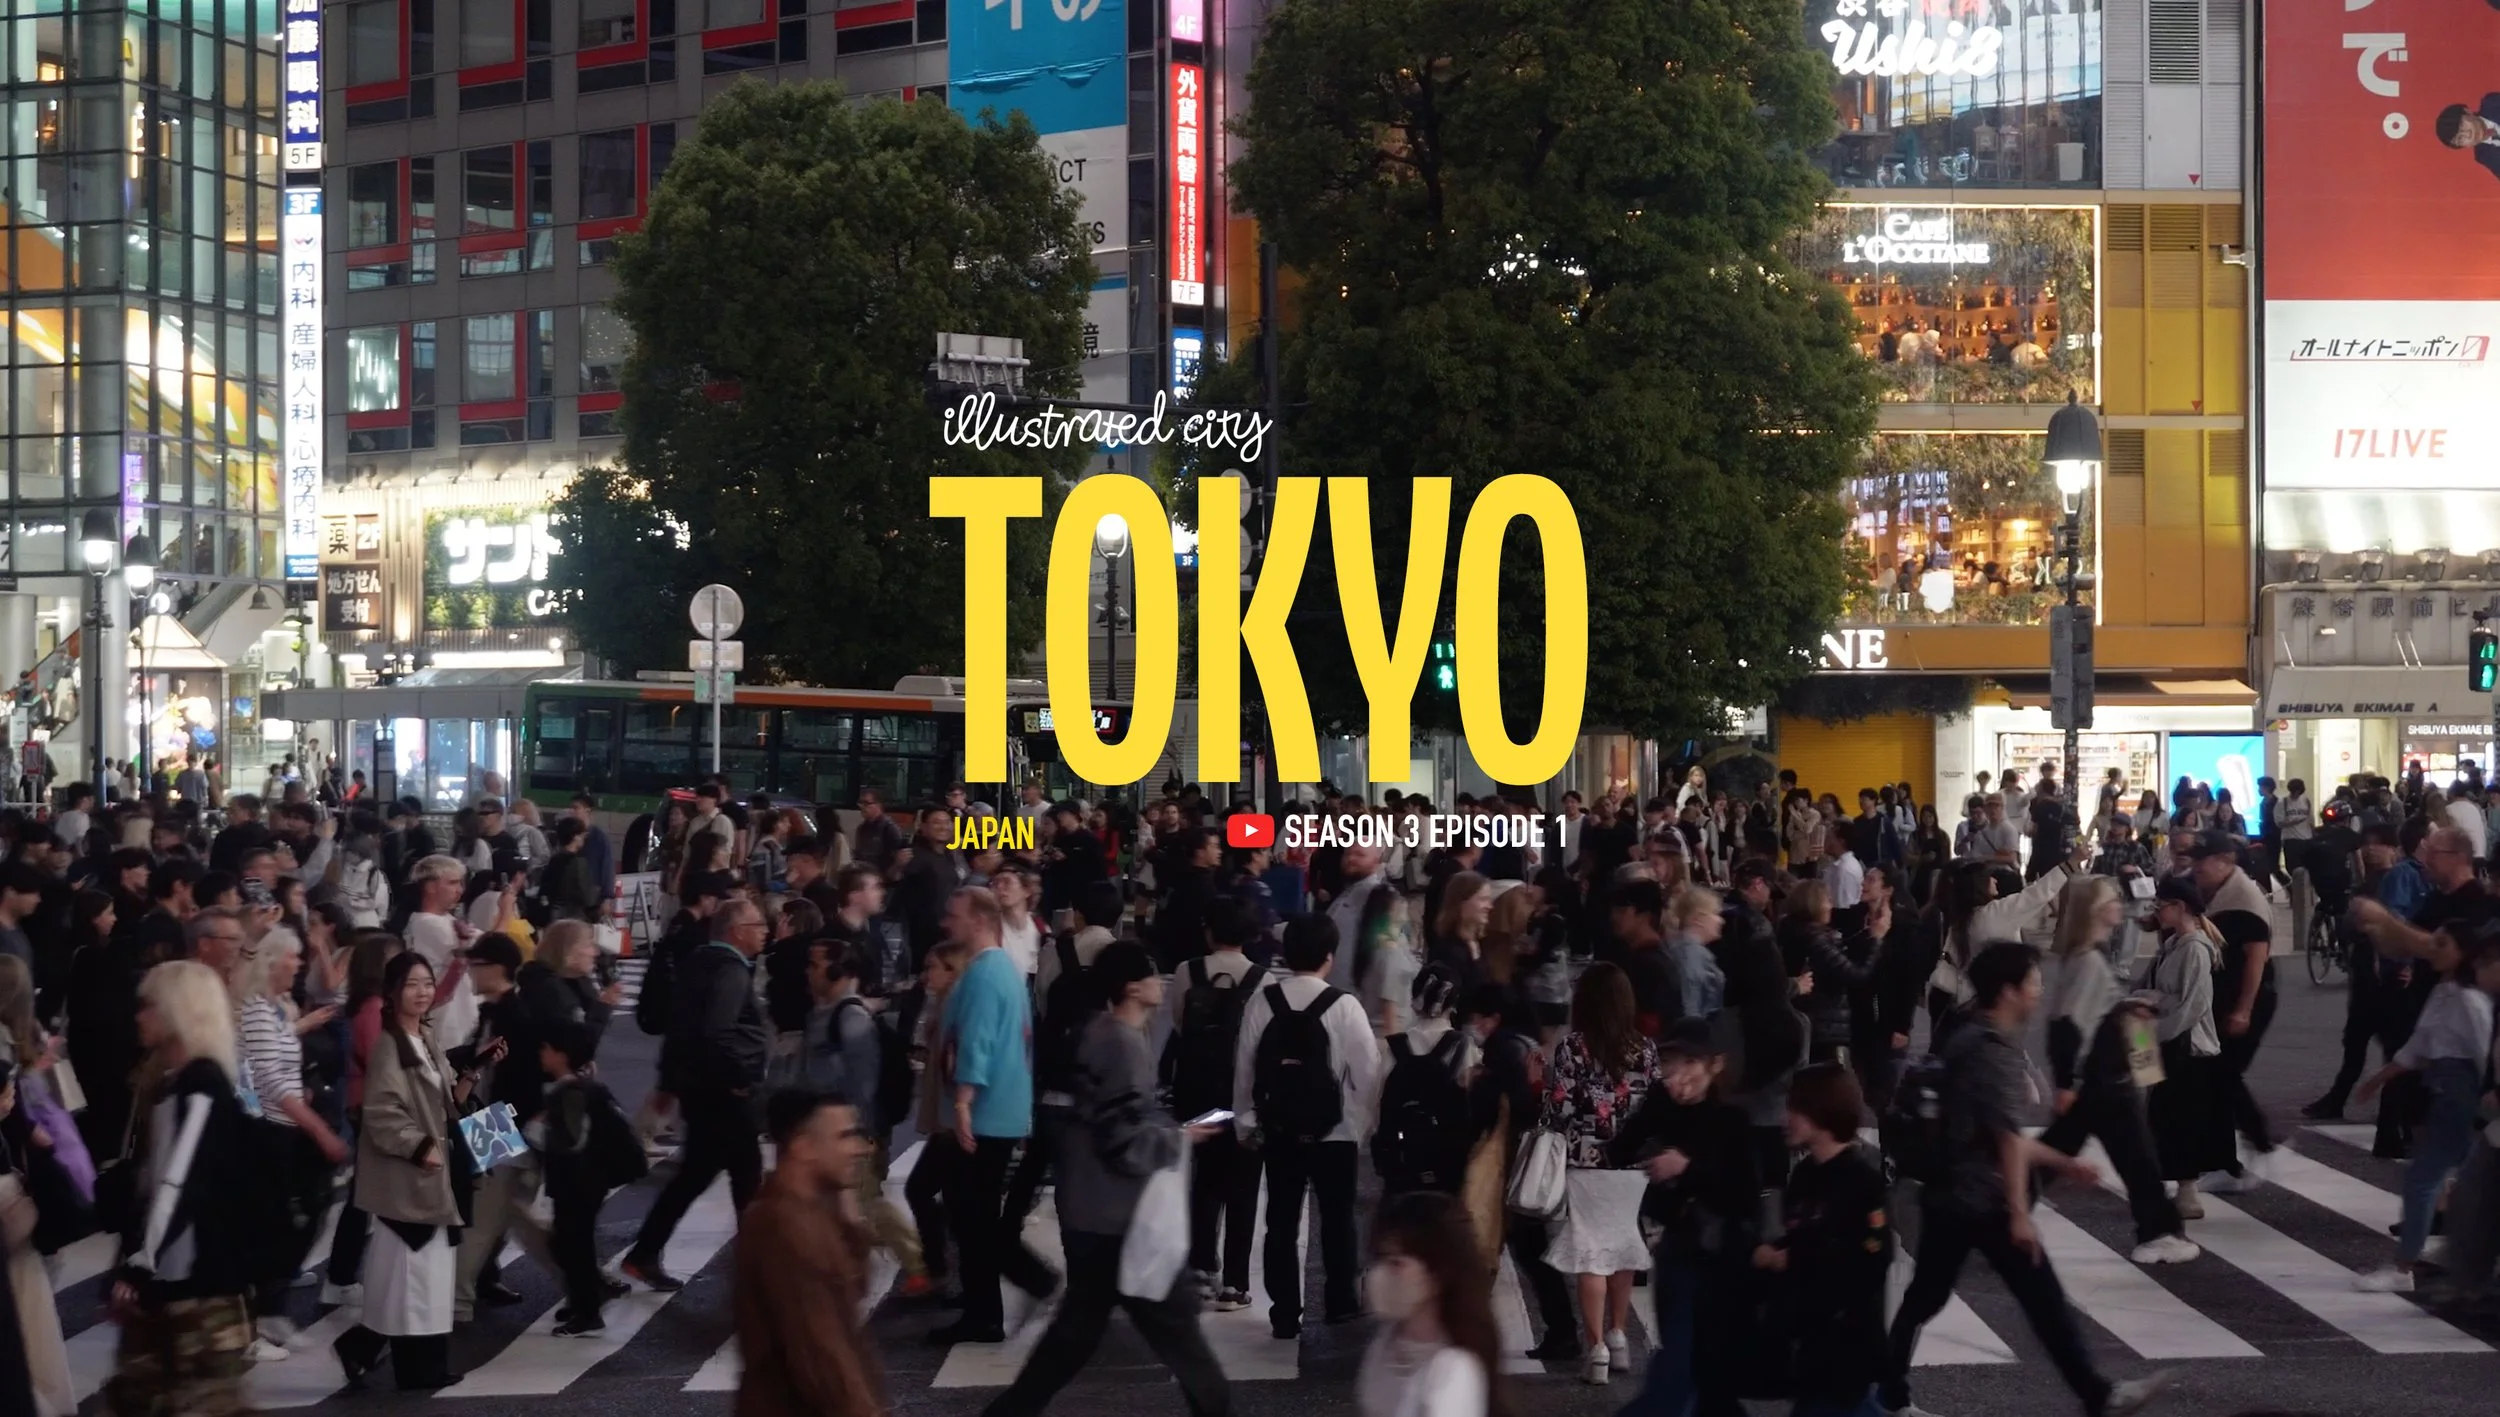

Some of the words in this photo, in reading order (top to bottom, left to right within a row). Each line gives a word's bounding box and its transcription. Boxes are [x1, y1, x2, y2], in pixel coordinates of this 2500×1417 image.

[1175, 15, 1197, 36] 4F
[1177, 67, 1197, 184] 外貨両替
[289, 193, 318, 214] 3F
[1179, 284, 1196, 301] 7F
[2334, 429, 2448, 459] 17LIVE
[1182, 555, 1194, 567] 3F
[327, 569, 381, 594] 処方せん
[341, 598, 370, 623] 受付
[2278, 703, 2344, 713] SHIBUYA
[2354, 703, 2415, 713] EKIMAE
[2408, 725, 2448, 736] SHIBUYA
[2449, 725, 2482, 736] EKIMAE
